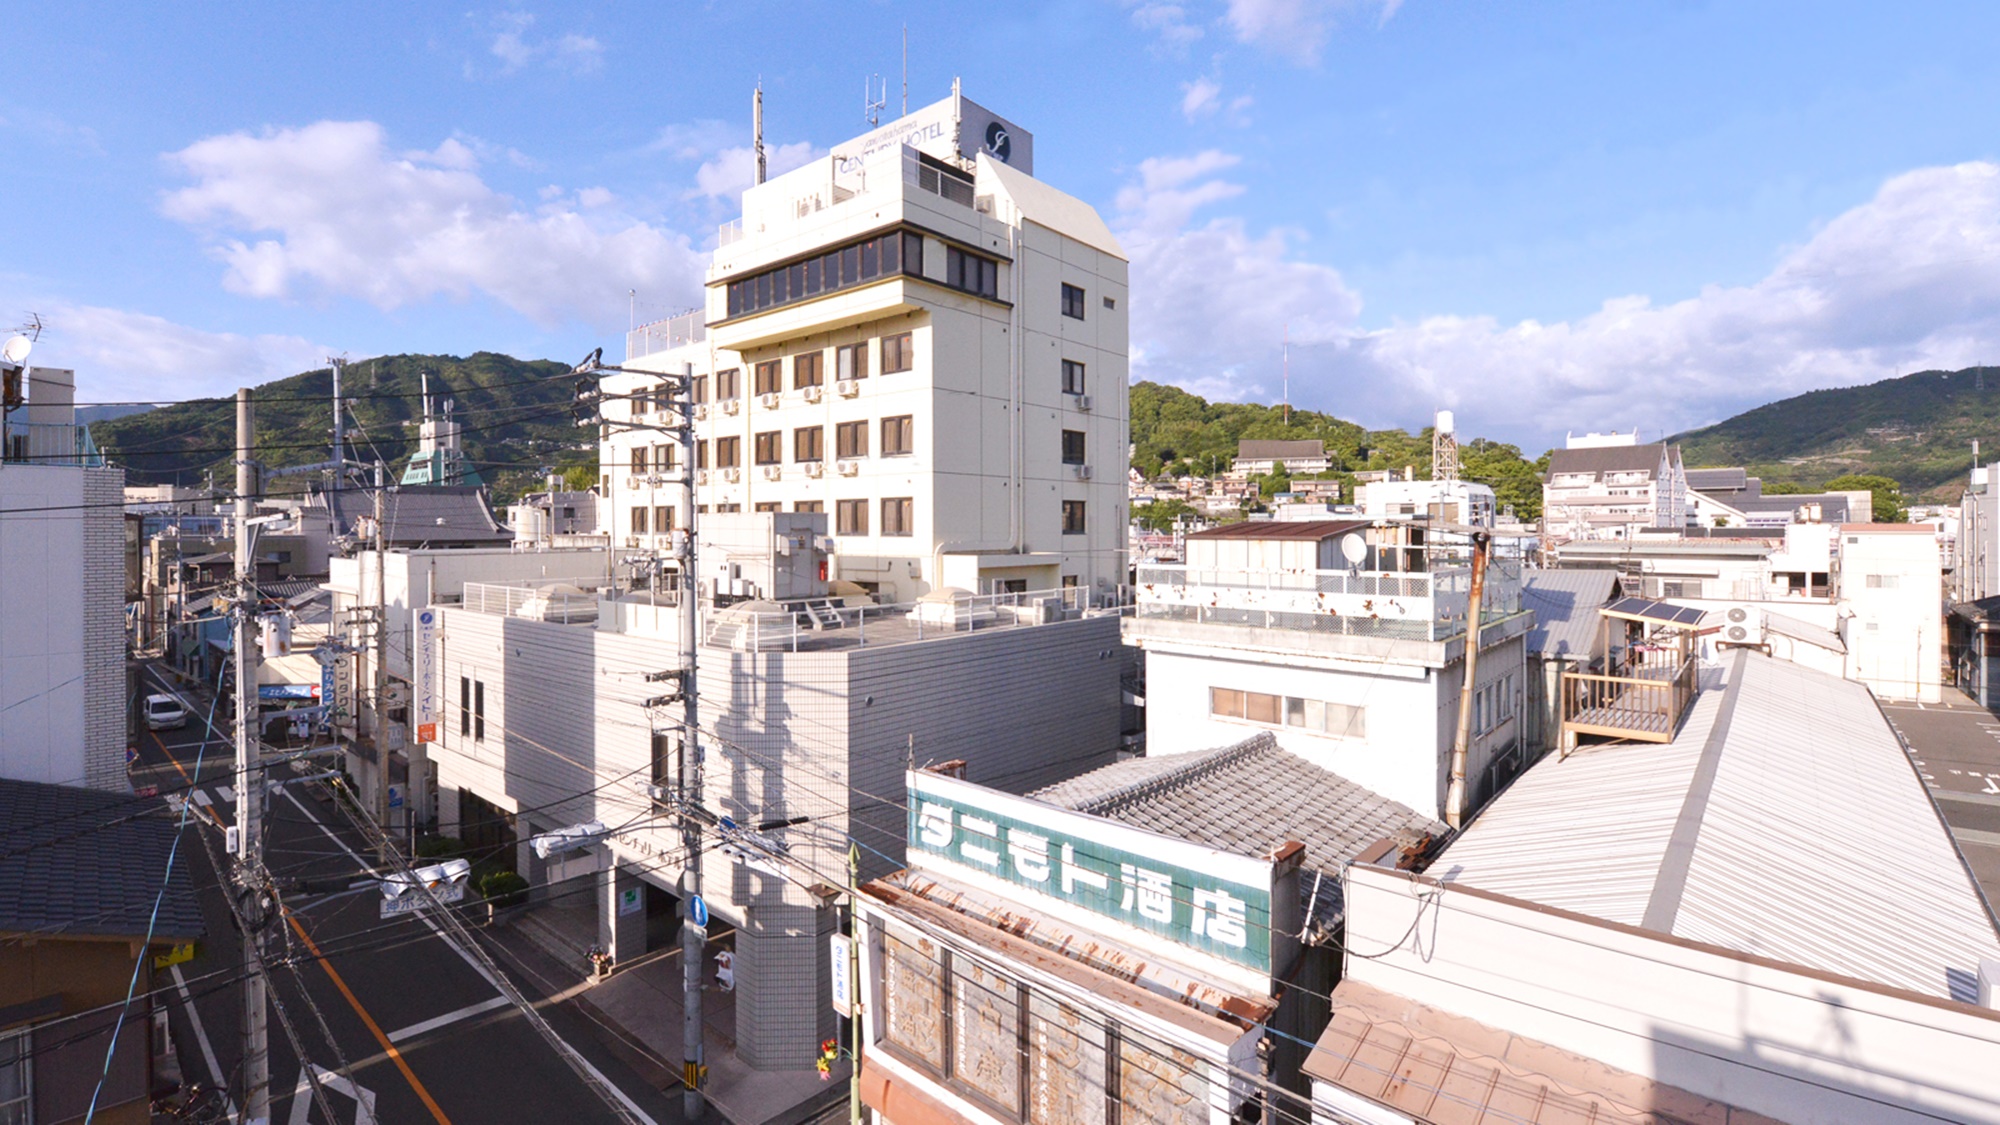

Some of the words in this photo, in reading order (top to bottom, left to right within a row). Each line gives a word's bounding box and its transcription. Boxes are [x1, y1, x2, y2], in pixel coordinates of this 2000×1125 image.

[901, 122, 944, 147] HOTEL
[918, 801, 1246, 949] タニモト酒店
